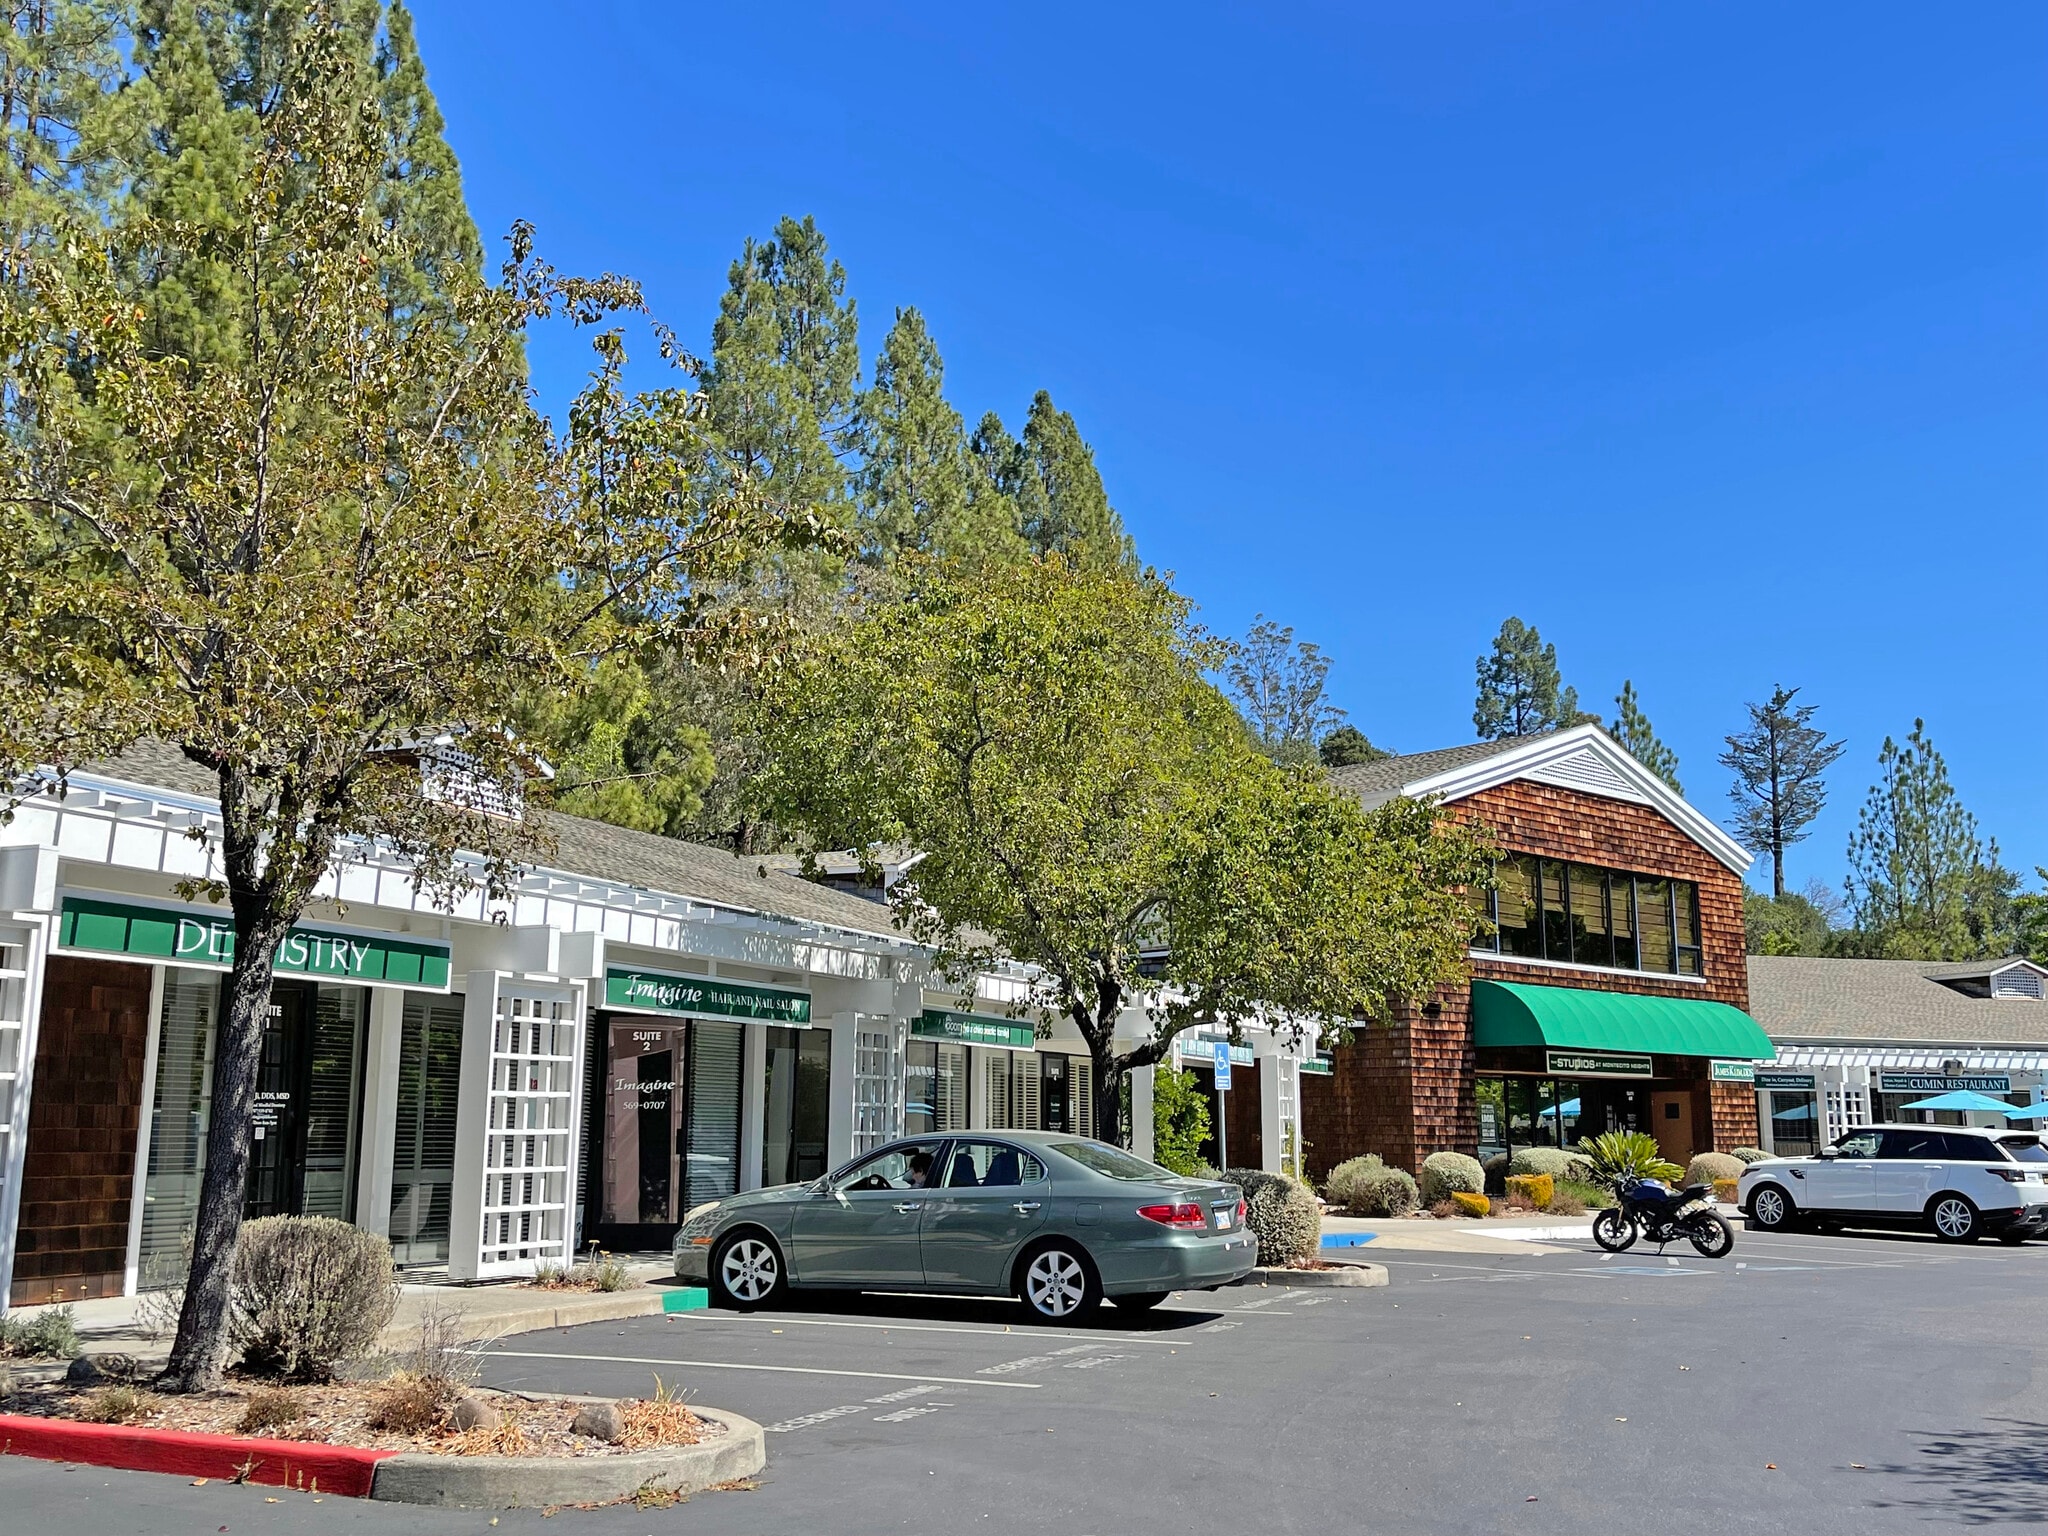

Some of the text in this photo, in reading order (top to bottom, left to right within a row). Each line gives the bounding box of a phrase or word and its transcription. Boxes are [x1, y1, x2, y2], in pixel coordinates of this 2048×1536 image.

[176, 918, 370, 972] DEISTRY
[625, 974, 703, 1005] Imagine
[711, 991, 801, 1012] HAIR AND NAIL SALON
[632, 1031, 662, 1041] SUITE
[643, 1041, 651, 1051] 2
[1557, 1058, 1595, 1070] STUDIOS
[614, 1078, 676, 1094] Imagine
[1910, 1078, 2007, 1090] CUMIN RESTAURANT
[623, 1101, 666, 1110] 569-0707
